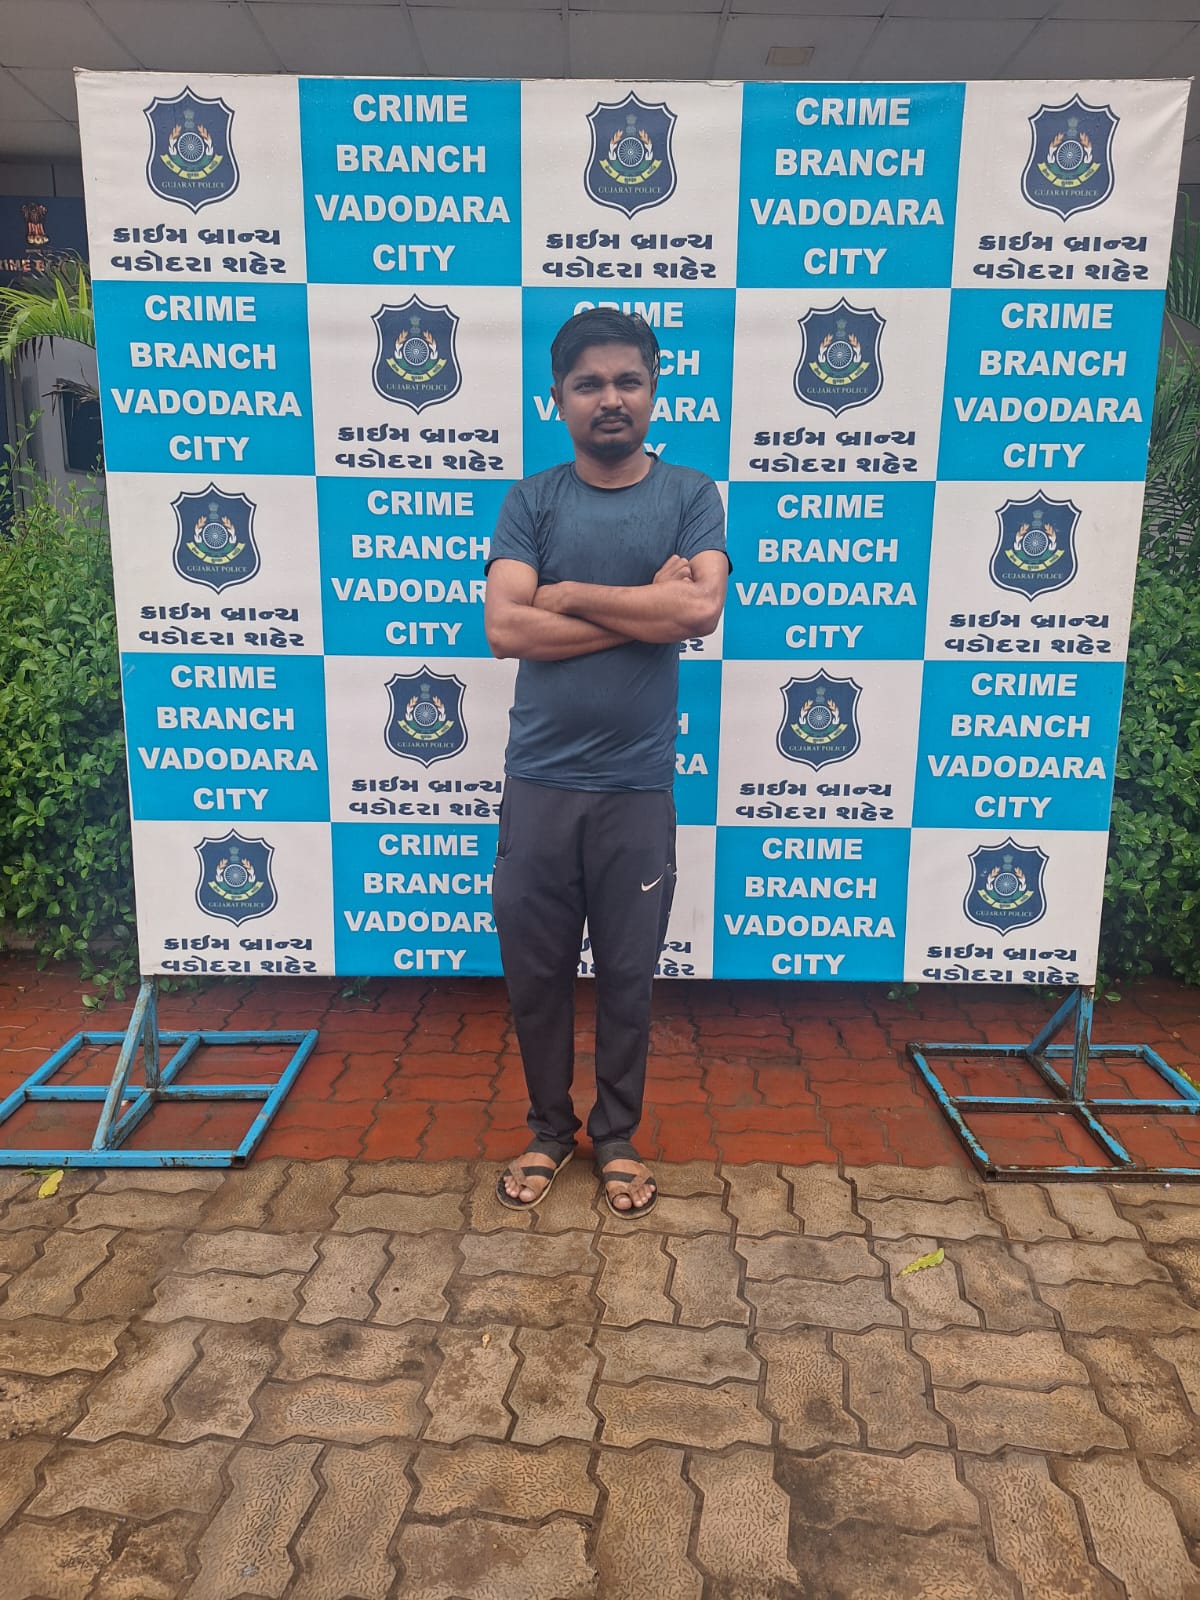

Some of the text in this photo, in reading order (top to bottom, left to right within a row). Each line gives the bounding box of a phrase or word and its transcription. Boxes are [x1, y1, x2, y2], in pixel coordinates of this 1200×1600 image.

[353, 94, 467, 122] CRIME
[796, 98, 911, 126] CRIME
[336, 144, 485, 173] BRANCH
[775, 149, 925, 176] BRANCH
[161, 181, 226, 189] GUJARAT POLICE
[598, 185, 662, 196] GUJARAT POLICE
[1034, 188, 1098, 197] GUJARAT POLICE
[315, 194, 510, 223] VADODARA
[750, 199, 944, 226] VADODARA
[199, 229, 280, 244] બ્રાન્ચ
[631, 235, 712, 249] બ્રાન્ચ
[1067, 237, 1147, 252] બ્રાન્ચ
[111, 250, 211, 272] વડોદરા
[223, 251, 286, 274] શહેર
[373, 244, 455, 271] CITY
[543, 256, 716, 280] વડોદરા શહેર
[804, 248, 887, 274] CITY
[973, 258, 1148, 281] વડોદરા શહેર
[145, 295, 256, 322] CRIME
[574, 302, 684, 328] IME
[1002, 302, 1113, 329] CRIME
[130, 342, 276, 370] BRANCH
[979, 350, 1126, 376] BRANCH
[386, 383, 449, 392] GUJARAT POLICE
[807, 386, 869, 395] GUJARAT POLICE
[111, 388, 302, 416] VADODARA
[533, 396, 721, 422] VARA
[954, 397, 1142, 422] VADODARA
[420, 429, 498, 443] બ્રાન્ચ
[836, 431, 915, 446] બ્રાન્ચ
[169, 435, 249, 461] CITY
[335, 448, 503, 471] વડોદરા શહેર
[1004, 443, 1085, 468] CITY
[750, 452, 917, 474] વડોદરા શહેર
[368, 490, 474, 516] CRIME
[777, 494, 884, 519] CRIME
[351, 534, 491, 560] BRANCH
[758, 539, 898, 563] BRANCH
[187, 565, 248, 573] GUJARAT POLICE
[1002, 572, 1063, 580] GUJARAT POLICE
[331, 577, 486, 603] VADODAR
[736, 582, 917, 606] VADODARA
[221, 608, 298, 621] બ્રાન્ચ
[1031, 615, 1108, 628] બ્રાન્ચ
[139, 626, 304, 647] વડોદરા શહેર
[386, 621, 462, 645] CITY
[786, 625, 863, 648] CITY
[945, 634, 1110, 654] વડોદરા શહેર
[171, 665, 276, 689] CRIME
[972, 673, 1077, 696] CRIME
[157, 707, 294, 730] BRANCH
[951, 714, 1090, 737] BRANCH
[397, 741, 455, 749] GUJARAT POLICE
[788, 745, 847, 753] GUJARAT POLICE
[138, 747, 318, 771] VADODARA
[928, 755, 1106, 779] VADODARA
[428, 780, 502, 793] બ્રાન્ચ
[817, 784, 891, 796] બ્રાન્ચ
[194, 788, 268, 810] CITY
[349, 798, 439, 815] વડોદરા
[975, 796, 1051, 818] CITY
[736, 801, 893, 821] વડોદરા શહેર
[379, 834, 478, 856] CRIME
[762, 838, 862, 860] CRIME
[363, 873, 492, 894] BRANCH
[745, 876, 876, 899] BRANCH
[344, 911, 497, 932] VADODAR
[975, 910, 1033, 918] GUJARAT POLICE
[724, 914, 895, 938] VADODARA
[240, 939, 312, 950] બ્રાન્ચ
[1003, 948, 1076, 961] બ્રાન્ચ
[161, 956, 317, 976] વડોદરા શહેર
[394, 949, 466, 970] CITY
[772, 953, 845, 975] CITY
[922, 965, 1079, 986] વડોદરા શહેર
